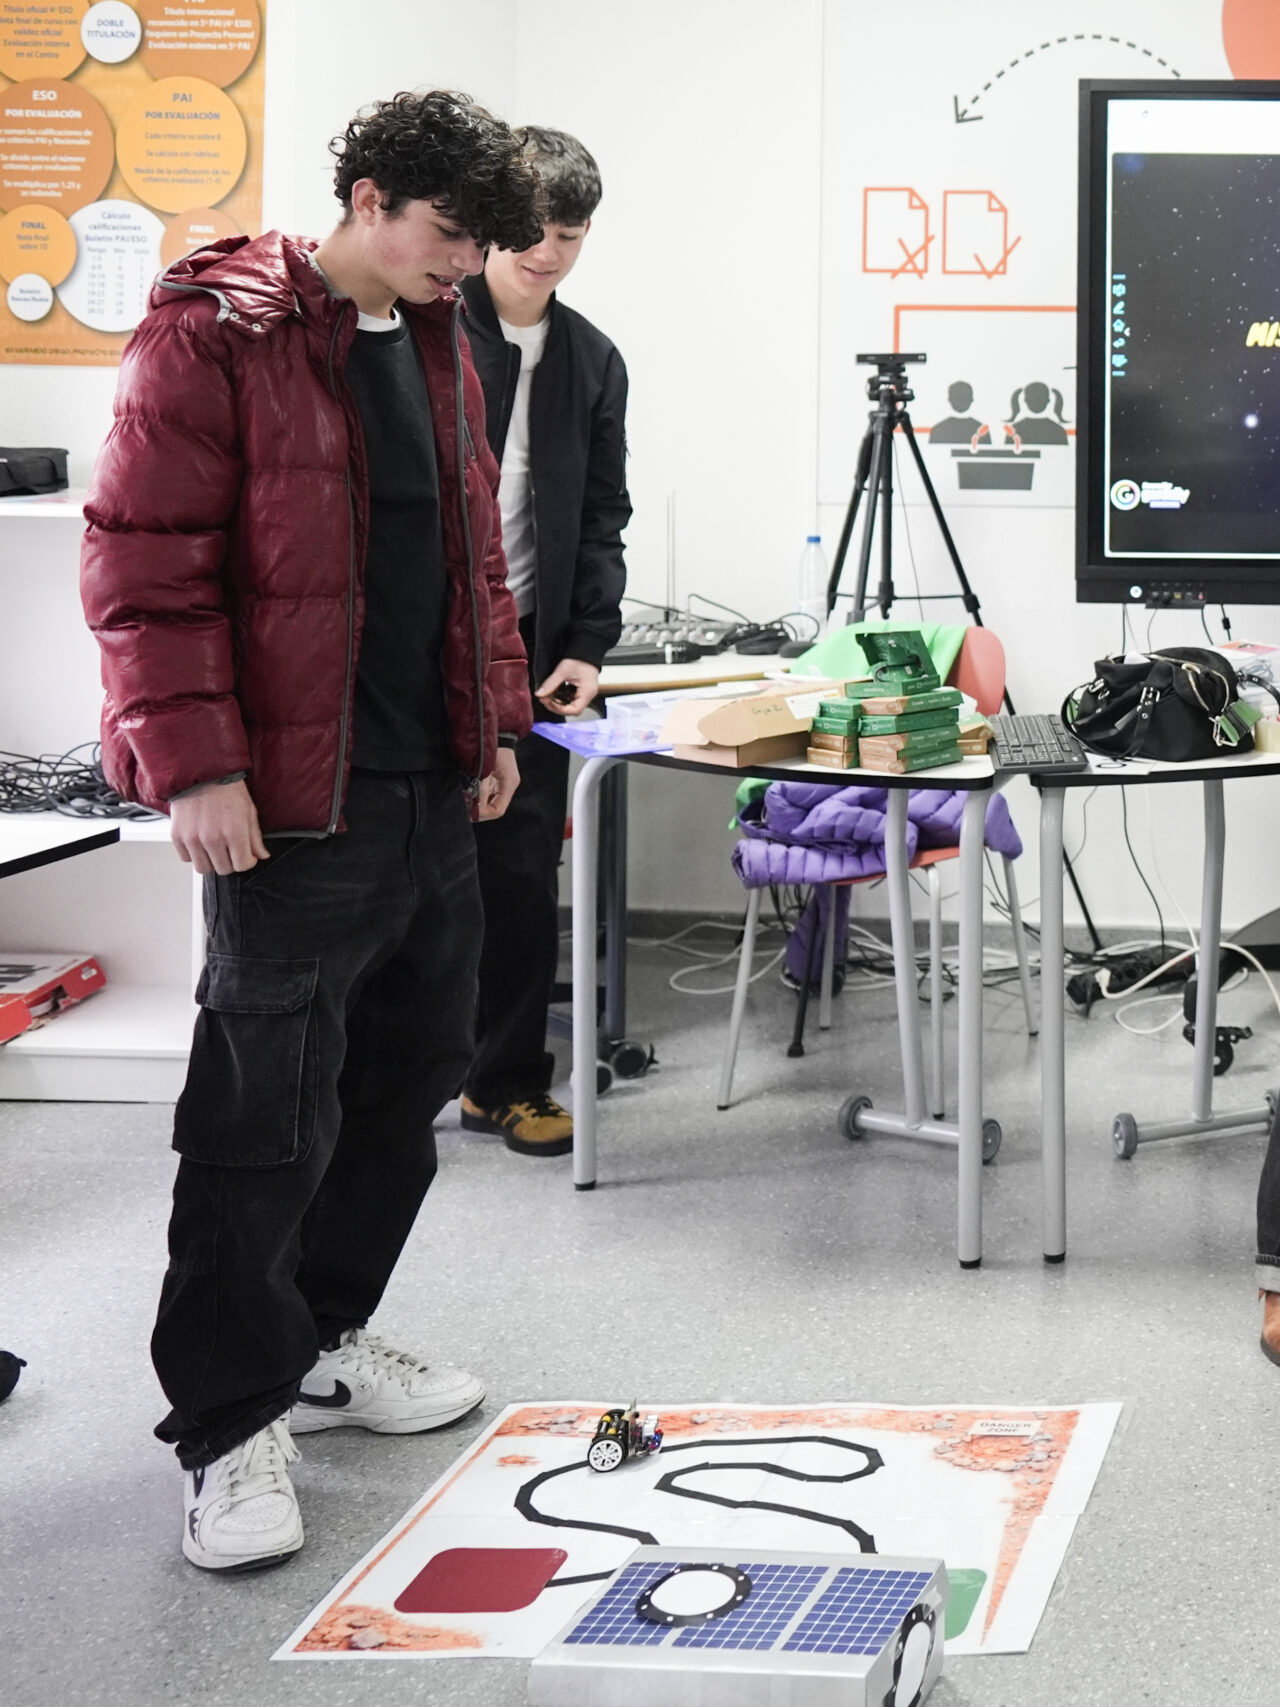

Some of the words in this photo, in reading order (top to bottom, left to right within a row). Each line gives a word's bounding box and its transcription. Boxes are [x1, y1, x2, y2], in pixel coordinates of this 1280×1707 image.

[97, 19, 124, 27] DOBLE
[87, 30, 136, 38] TITULACIÓN
[32, 90, 57, 100] ESO
[172, 93, 192, 102] PAI
[145, 111, 163, 119] POR
[164, 111, 220, 120] EVALUACIÓN
[88, 223, 141, 231] calificaciones
